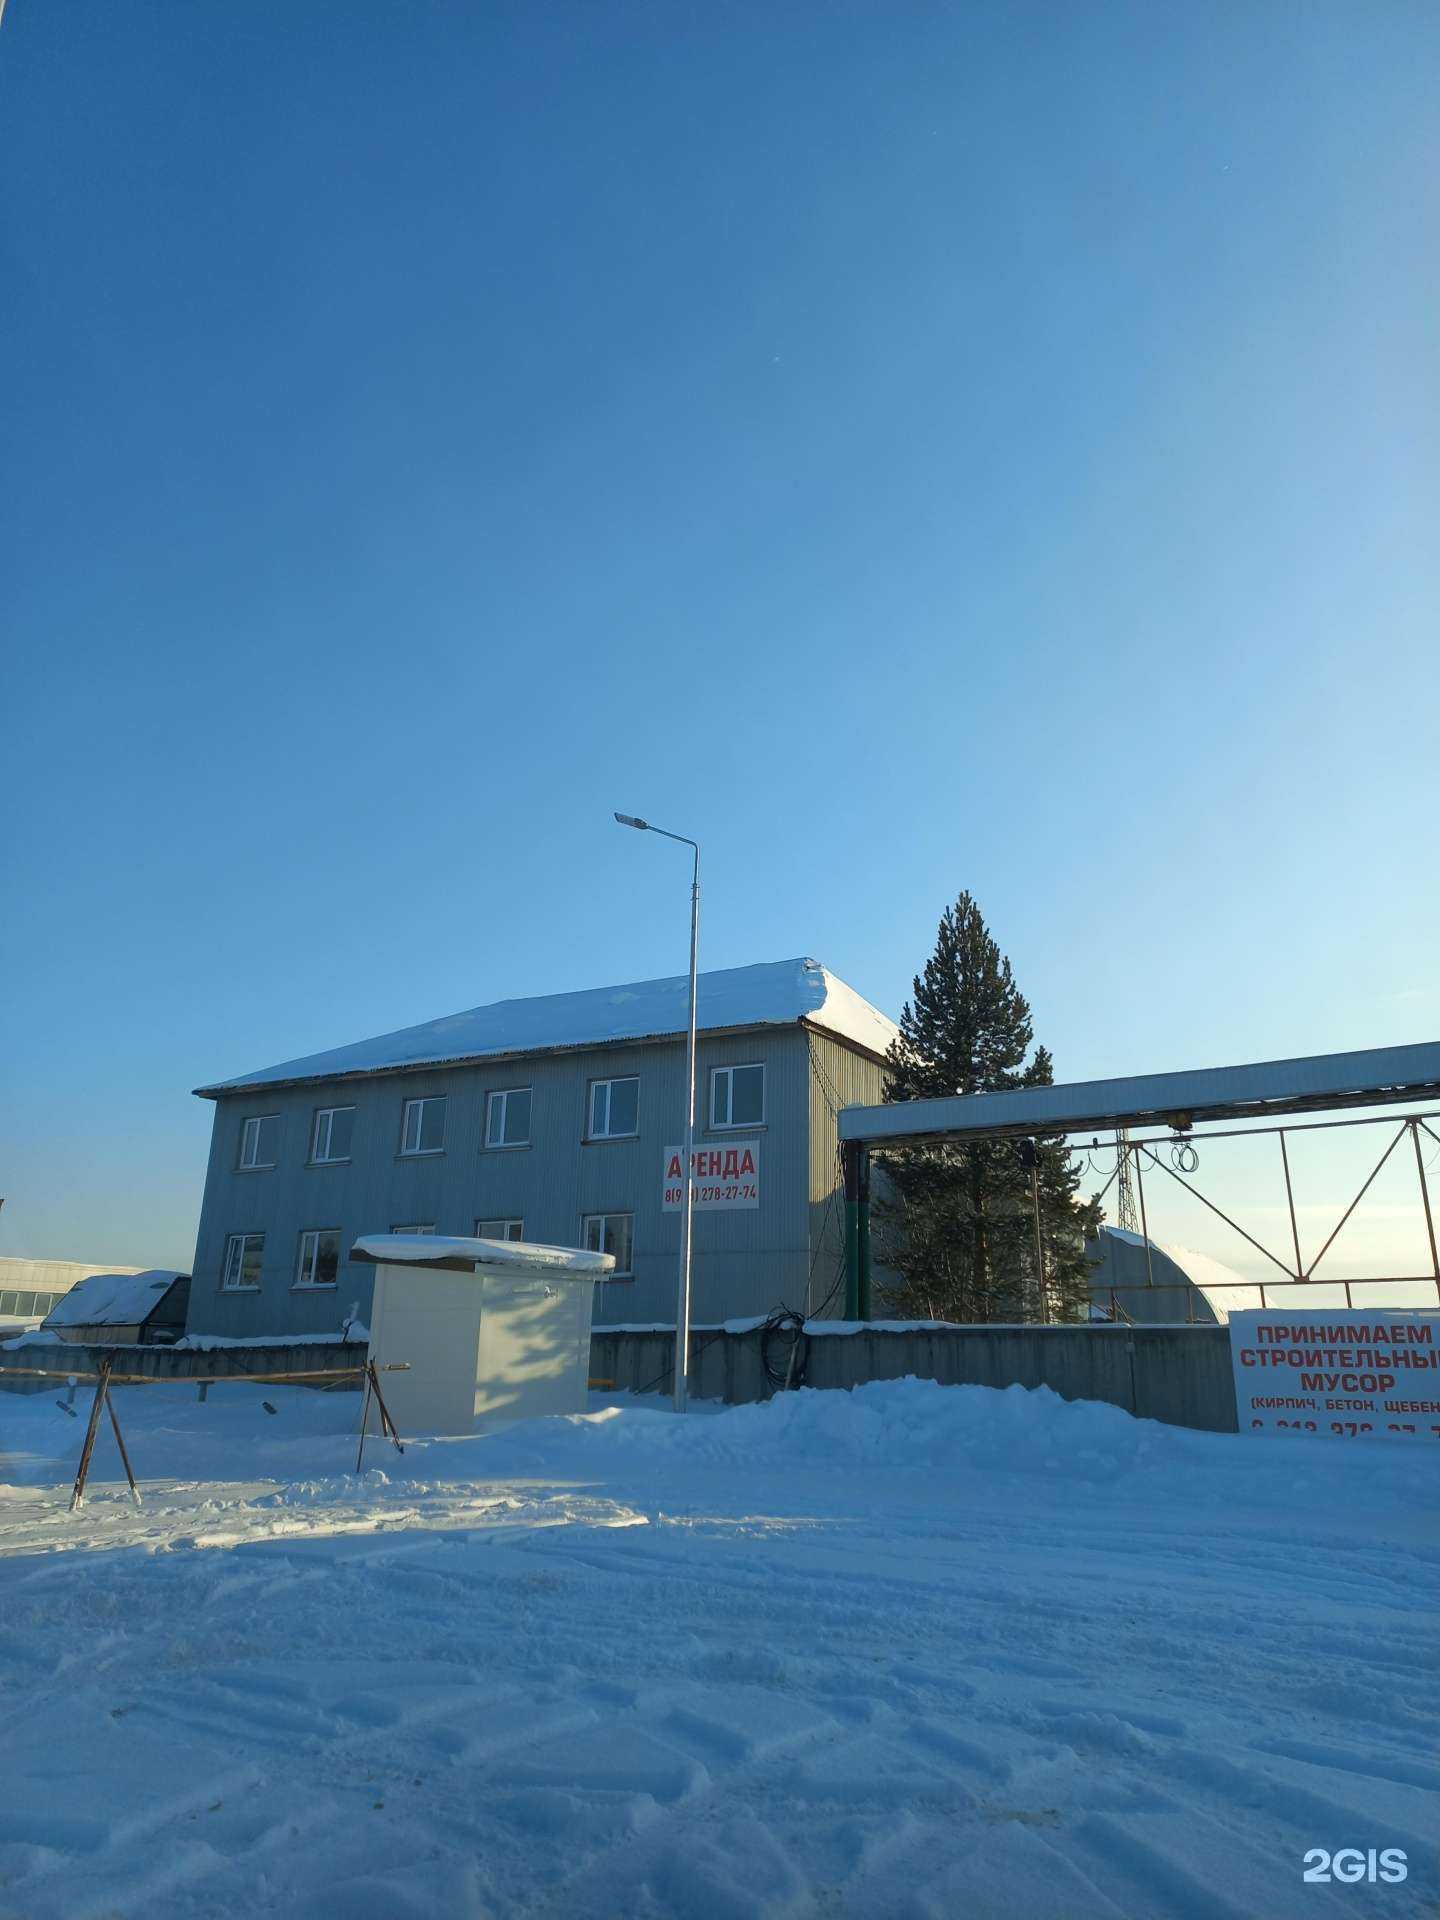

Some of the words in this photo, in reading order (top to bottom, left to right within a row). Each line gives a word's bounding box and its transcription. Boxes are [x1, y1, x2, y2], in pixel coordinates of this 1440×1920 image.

[702, 1184, 756, 1201] 278-27-74
[1257, 1325, 1433, 1344] ПРИНИМАЕМ
[1240, 1348, 1440, 1369] СТРОИТЕЛЬНЫ
[1300, 1373, 1396, 1393] МУСОР
[1325, 1399, 1378, 1413] БЕТОН,
